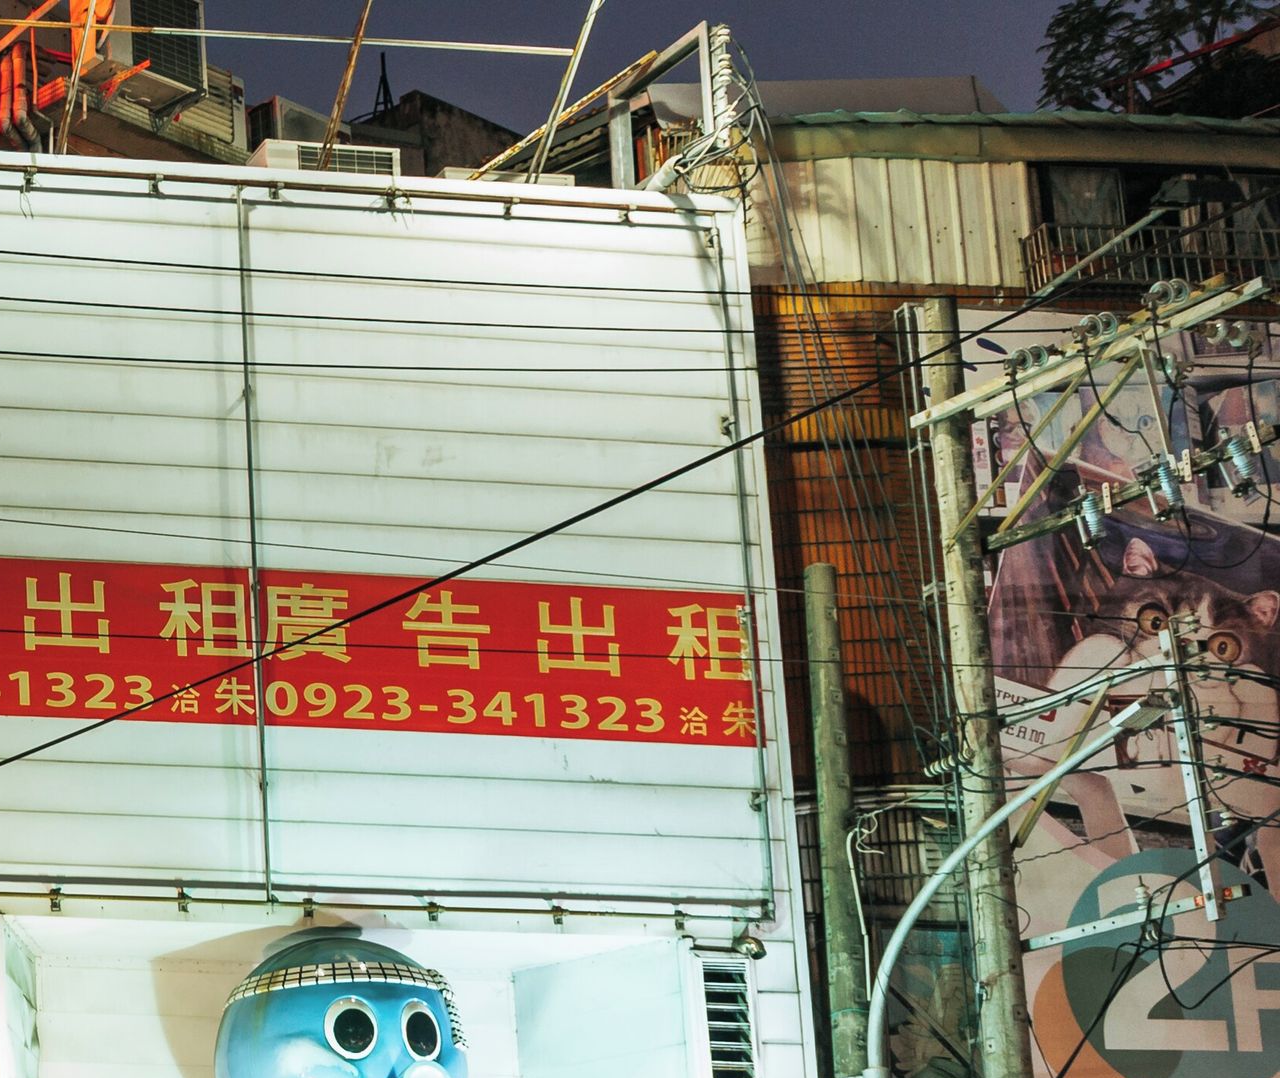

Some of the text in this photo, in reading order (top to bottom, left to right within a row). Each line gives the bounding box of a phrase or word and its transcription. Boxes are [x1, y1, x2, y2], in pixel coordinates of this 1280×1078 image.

[265, 583, 752, 682] 廣告出租
[266, 681, 665, 733] 0923-341323
